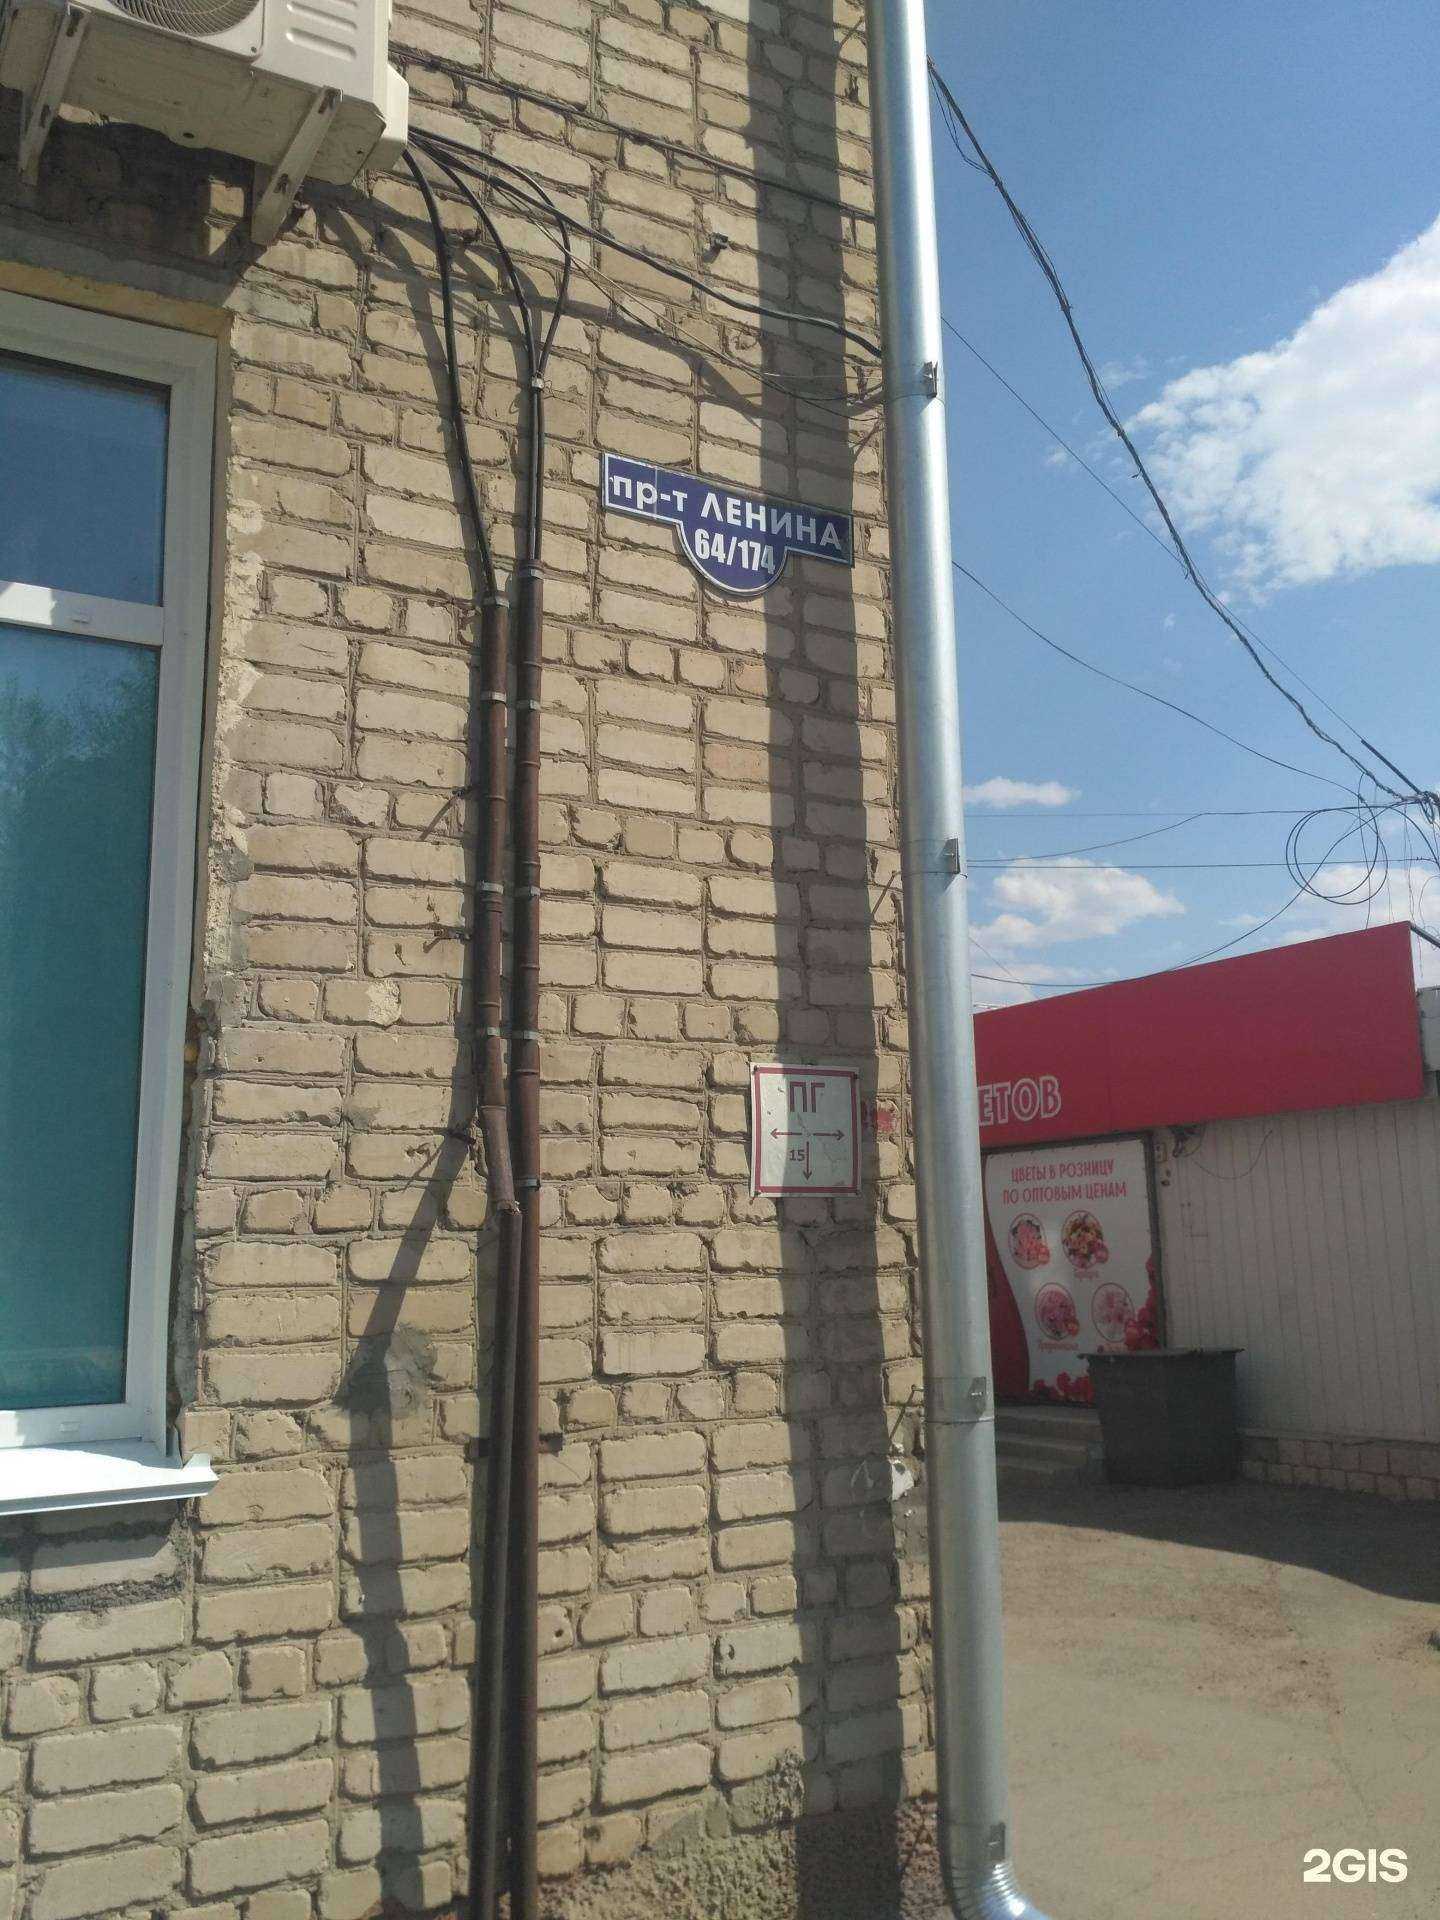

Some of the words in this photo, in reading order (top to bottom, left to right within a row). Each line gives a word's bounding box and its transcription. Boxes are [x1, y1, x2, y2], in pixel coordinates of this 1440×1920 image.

[611, 475, 688, 512] пр-т
[700, 492, 842, 550] ЛЕНИНА
[694, 528, 776, 575] 64/174
[789, 1081, 826, 1113] ПГ
[789, 1149, 805, 1162] 15
[1011, 1166, 1046, 1184] ЦВЕТЫ
[1047, 1166, 1056, 1179] В
[1059, 1159, 1114, 1179] РОЗНИЦУ
[1002, 1188, 1019, 1205] ПО
[1022, 1184, 1082, 1203] ОПТОВЫМ
[1086, 1181, 1127, 1201] ЦЕНАМ
